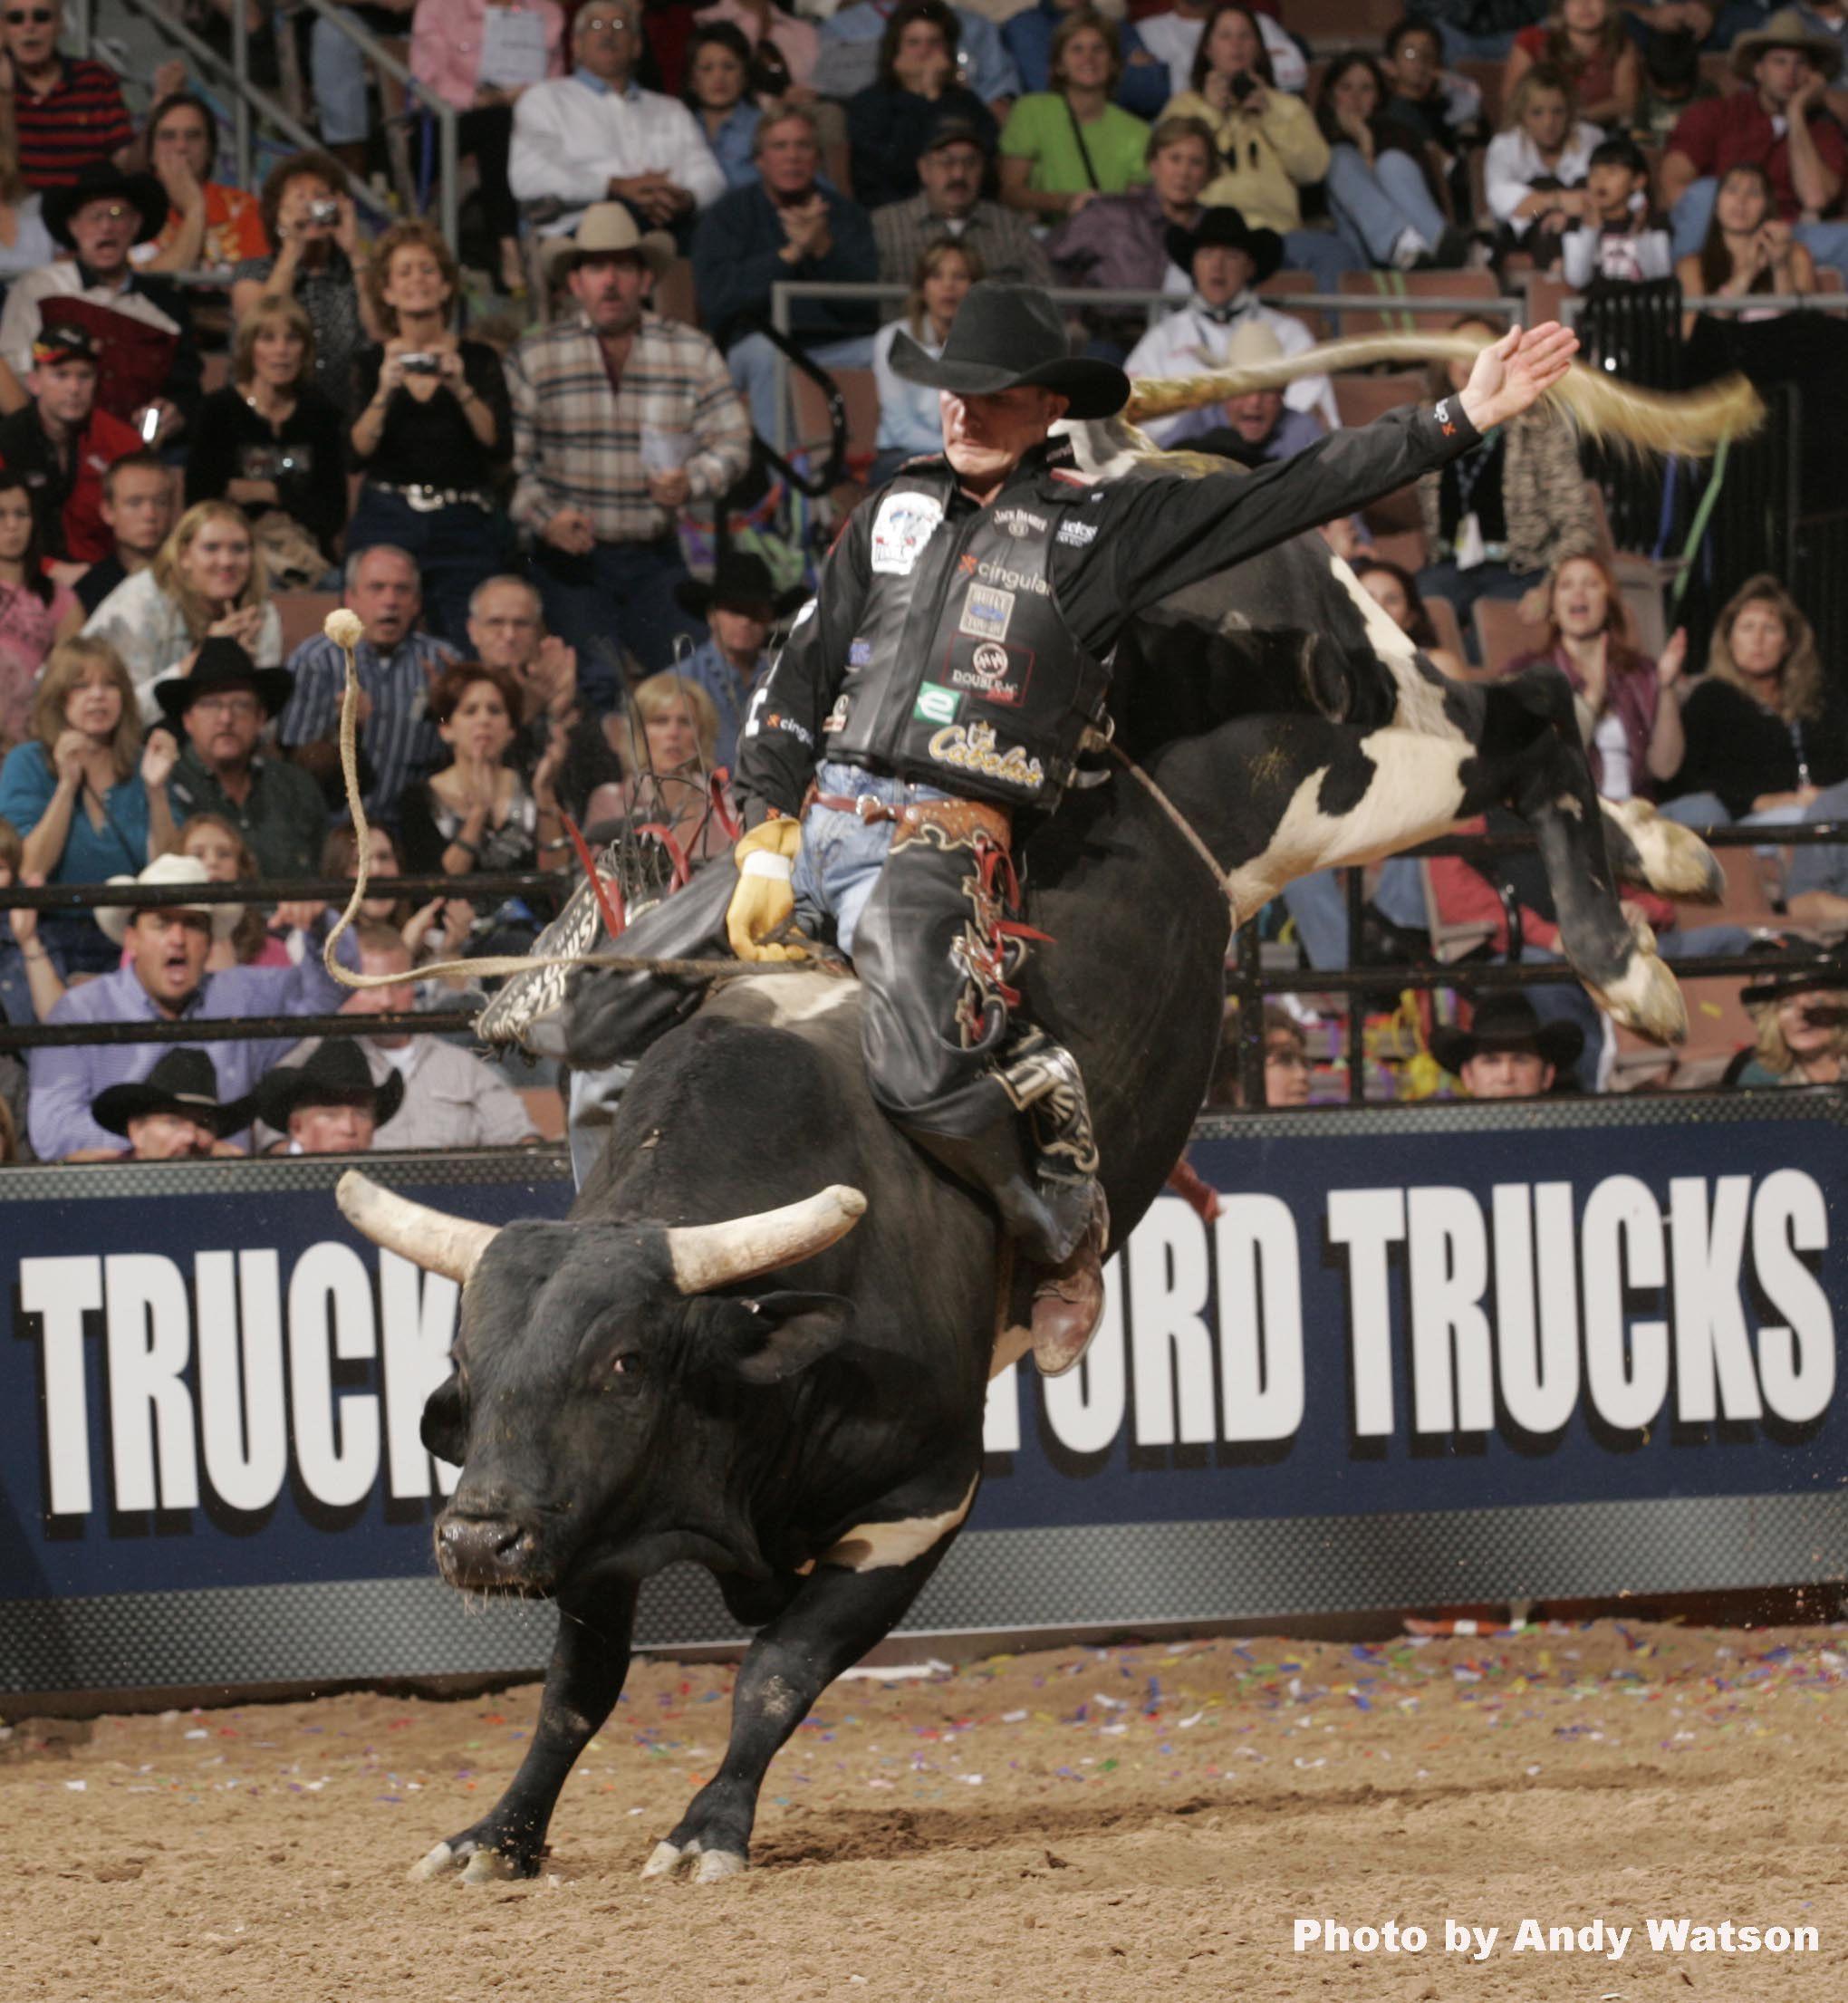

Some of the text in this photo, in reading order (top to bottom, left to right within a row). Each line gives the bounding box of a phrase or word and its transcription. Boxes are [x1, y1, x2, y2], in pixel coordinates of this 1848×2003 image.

[780, 717, 814, 750] cing
[20, 1240, 462, 1516] TRUCK
[1326, 1168, 1837, 1438] TRUCKS
